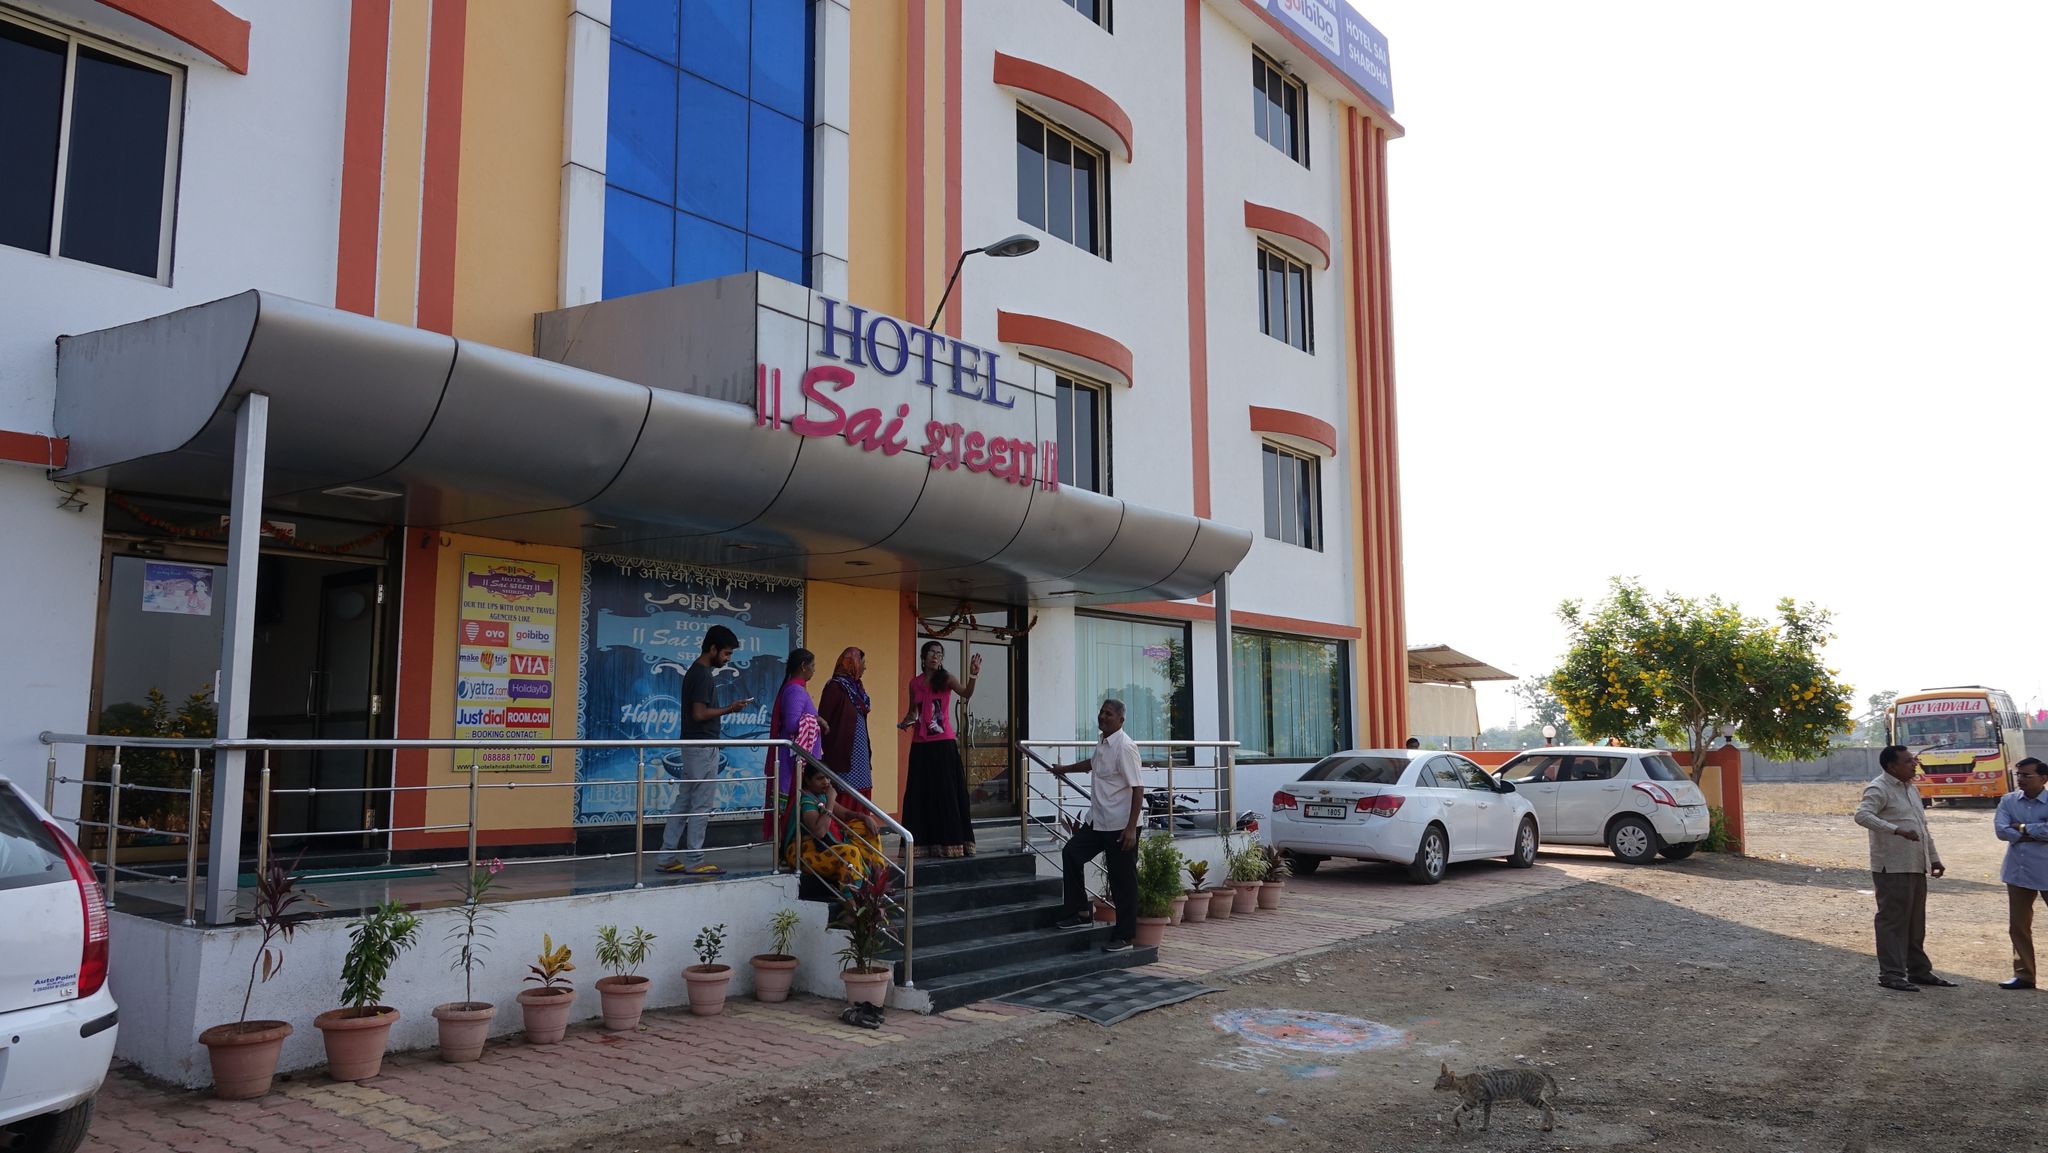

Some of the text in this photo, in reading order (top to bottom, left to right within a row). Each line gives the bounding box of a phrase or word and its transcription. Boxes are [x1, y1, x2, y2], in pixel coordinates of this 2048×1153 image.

[1345, 17, 1387, 65] HOTEL SAI
[1348, 42, 1389, 89] SHARDHA
[817, 296, 1015, 409] HOTEL
[791, 365, 909, 456] Sai
[463, 600, 555, 615] OUR TIE UPS WITH ONLINE TRAVEL
[490, 612, 530, 622] AGENCIES LIKE
[675, 620, 712, 632] HOT
[516, 629, 550, 641] goibibo
[650, 629, 690, 647] Sai
[460, 652, 479, 663] make
[495, 654, 507, 666] trip
[514, 655, 546, 674] VIA
[469, 681, 549, 699] yatra.com HolidayIQ
[457, 708, 549, 725] Justdial ROOM.COM
[1901, 700, 1982, 717] JAY VADVALA
[621, 703, 680, 733] Happy
[472, 730, 537, 738] BOOKING CONTACT
[482, 753, 536, 762] 088888 17700
[1327, 808, 1341, 817] 1805
[56, 973, 76, 981] Point
